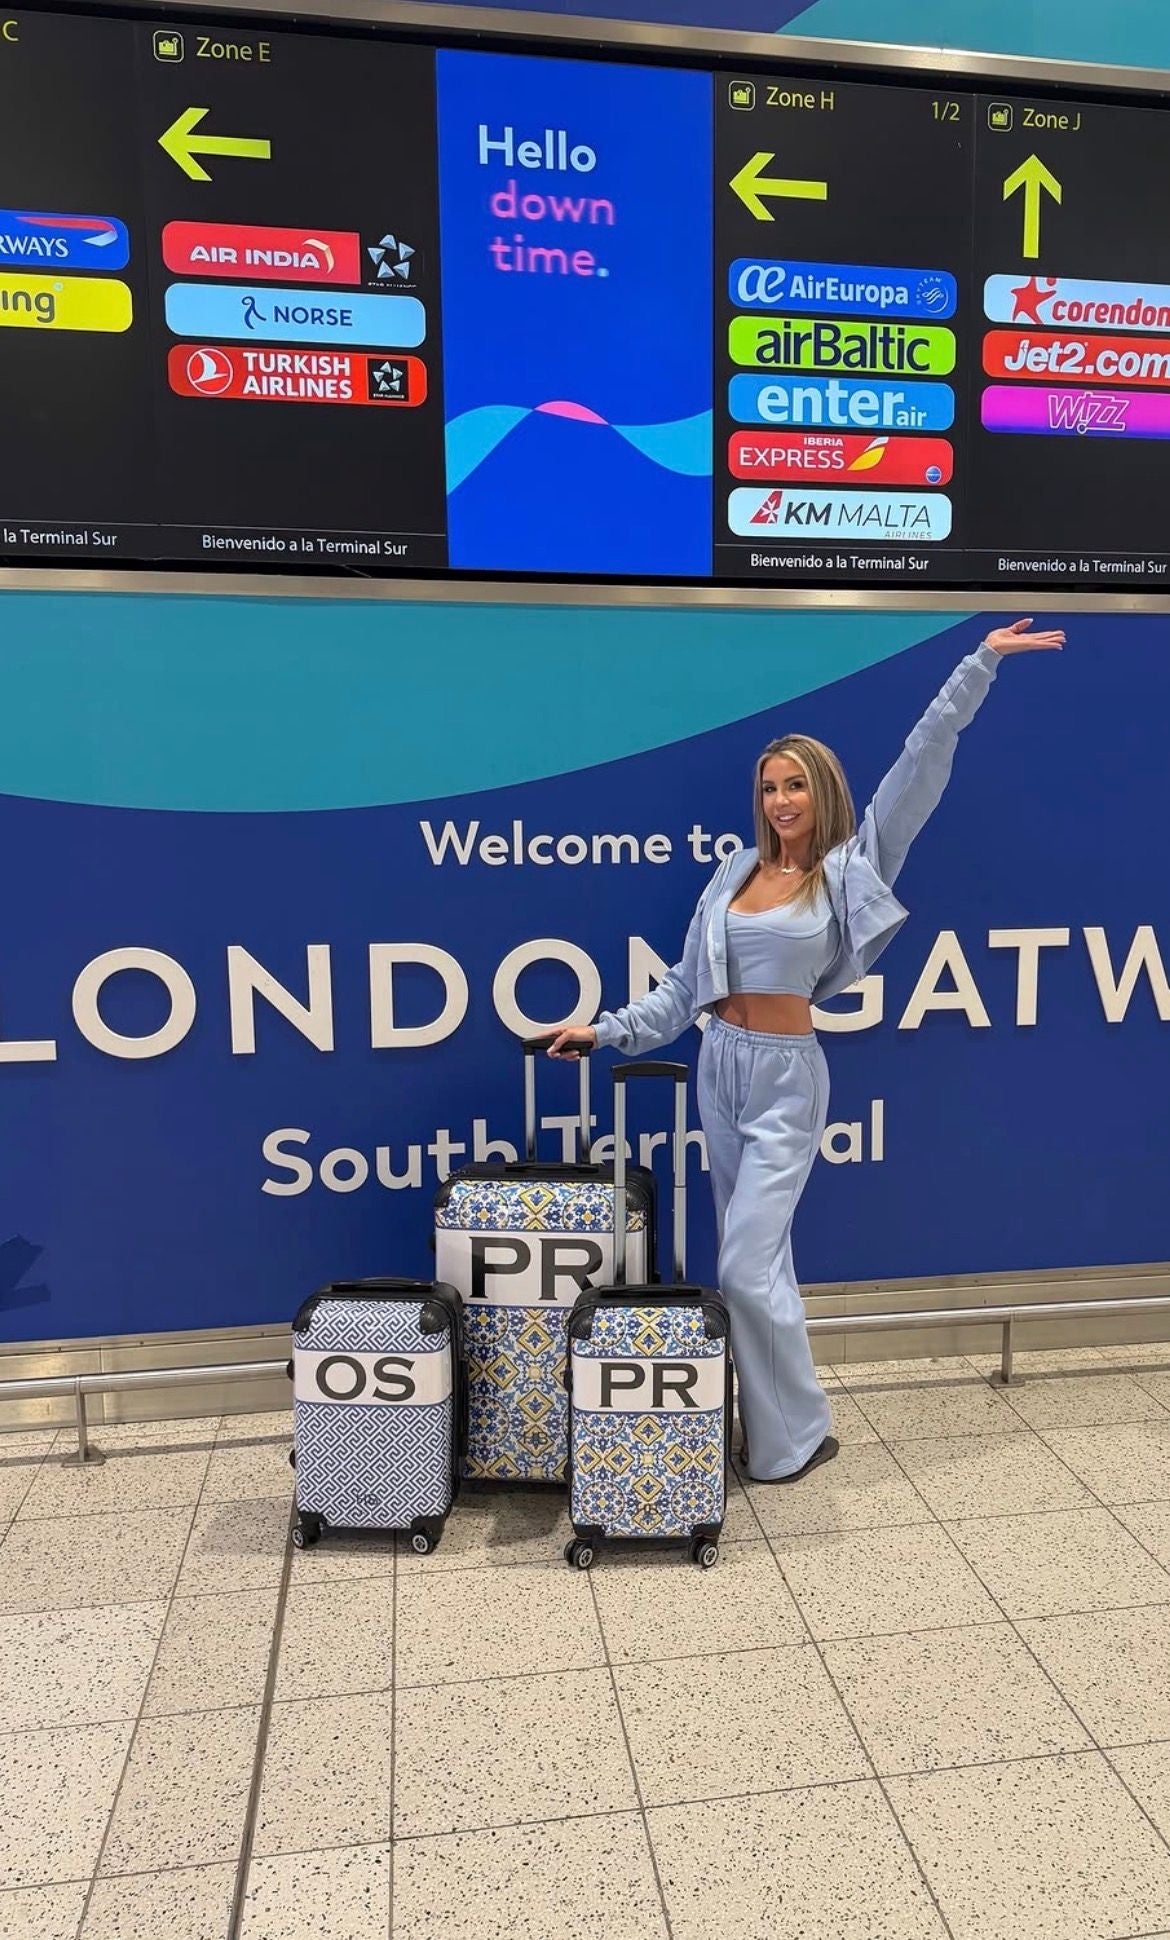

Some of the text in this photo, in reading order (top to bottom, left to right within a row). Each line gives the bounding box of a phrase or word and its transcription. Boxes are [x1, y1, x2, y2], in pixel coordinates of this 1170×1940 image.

[2, 20, 19, 42] C
[196, 37, 271, 63] Zone E
[766, 86, 835, 110] Zone H
[931, 101, 960, 121] 1/2
[1023, 108, 1081, 131] Zone J
[478, 124, 597, 173] Hello
[490, 178, 616, 226] down
[189, 245, 320, 269] AIR INDIA
[489, 233, 610, 278] time.
[789, 275, 909, 309] AirEuropa
[273, 306, 353, 327] NORSE
[1051, 298, 1170, 327] corendon
[755, 321, 931, 371] airBaltic
[1004, 339, 1170, 379] Jet2.com
[243, 352, 352, 376] TURKISH
[243, 376, 353, 399] AIRLINES
[757, 378, 927, 428] enter air
[803, 437, 844, 447] IBERIA
[739, 448, 845, 470] EXPRESS
[784, 501, 931, 529] KM MALTA
[4, 528, 117, 546] la Terminal Sur
[202, 535, 408, 556] Bienvenido a la Terminal Sur
[750, 554, 929, 570] Bienvenido a la Terminal Sur
[998, 558, 1167, 573] Bienvenido a la Terminal Sur
[420, 820, 743, 866] Welcome to
[261, 1100, 884, 1197] South Teral
[469, 1236, 604, 1301] PR
[315, 1356, 416, 1402] OS
[600, 1362, 699, 1408] PR
